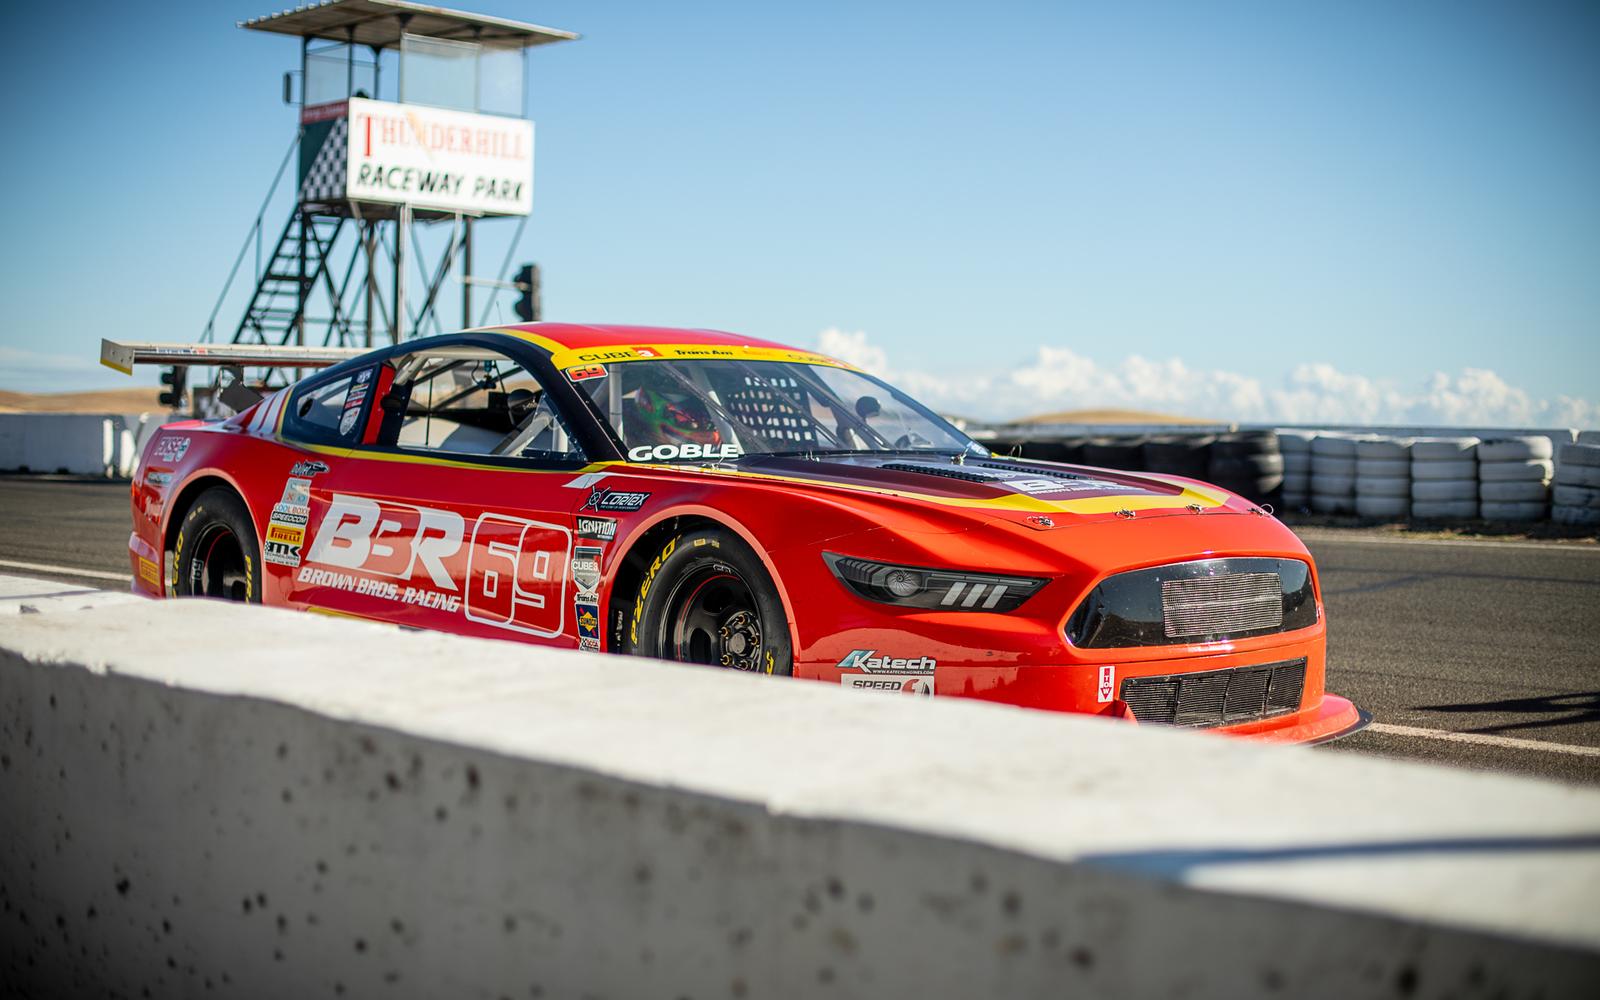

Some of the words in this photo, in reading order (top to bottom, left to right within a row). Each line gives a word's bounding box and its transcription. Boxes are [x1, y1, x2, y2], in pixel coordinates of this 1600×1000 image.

[357, 163, 464, 194] RACEWAY
[473, 176, 523, 200] PARK
[628, 443, 738, 462] GOBLE
[271, 527, 301, 542] PIRELLI
[464, 512, 573, 638] 69
[297, 567, 357, 590] BROWN
[357, 578, 399, 600] BROS.
[401, 587, 461, 613] RACING
[851, 650, 936, 673] Katech
[853, 680, 902, 690] SPEED
